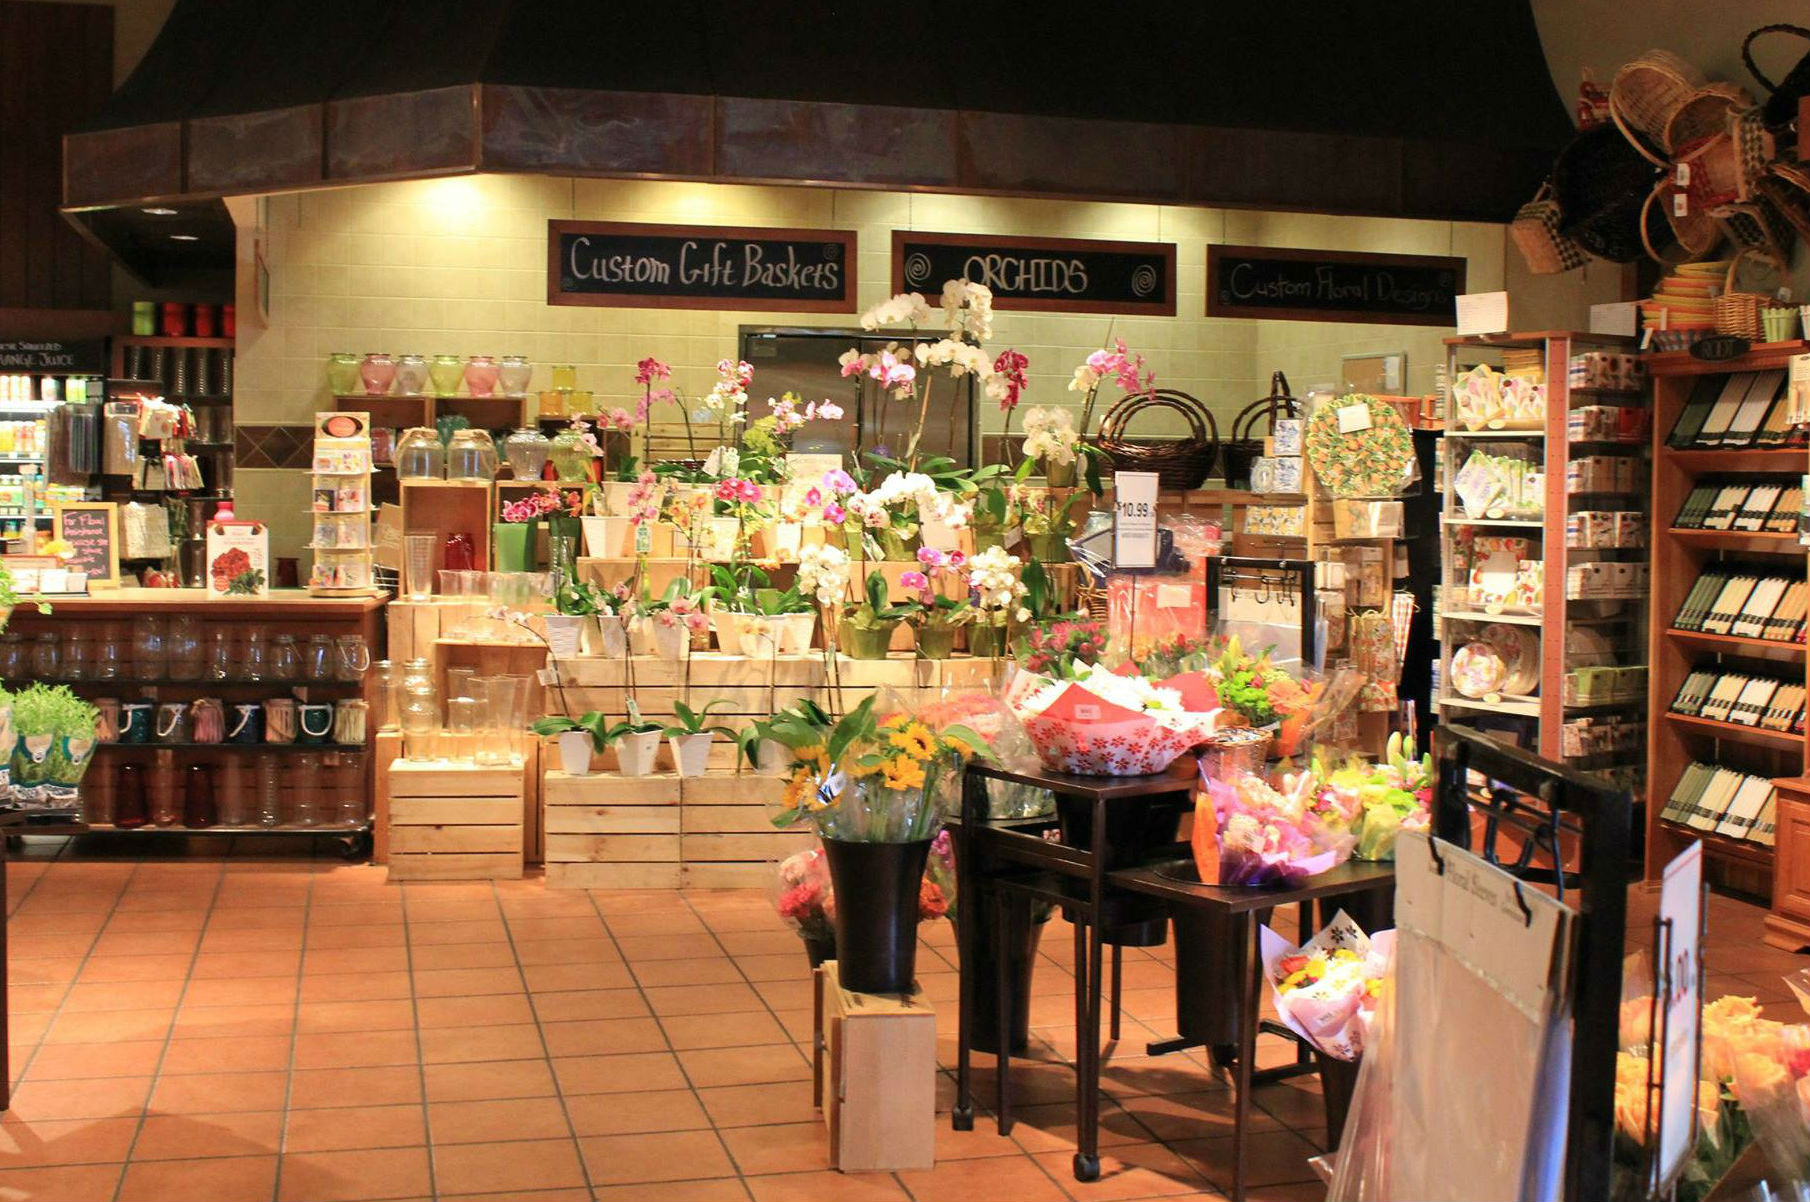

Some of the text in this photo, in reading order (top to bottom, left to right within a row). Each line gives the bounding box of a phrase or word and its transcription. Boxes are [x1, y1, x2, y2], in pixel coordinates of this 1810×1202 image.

[571, 238, 838, 289] Custom Gift Baskets
[963, 253, 1089, 293] ORCHIDS
[1230, 263, 1312, 299] Custom
[1315, 265, 1368, 300] Floral
[1117, 502, 1148, 517] $10.99
